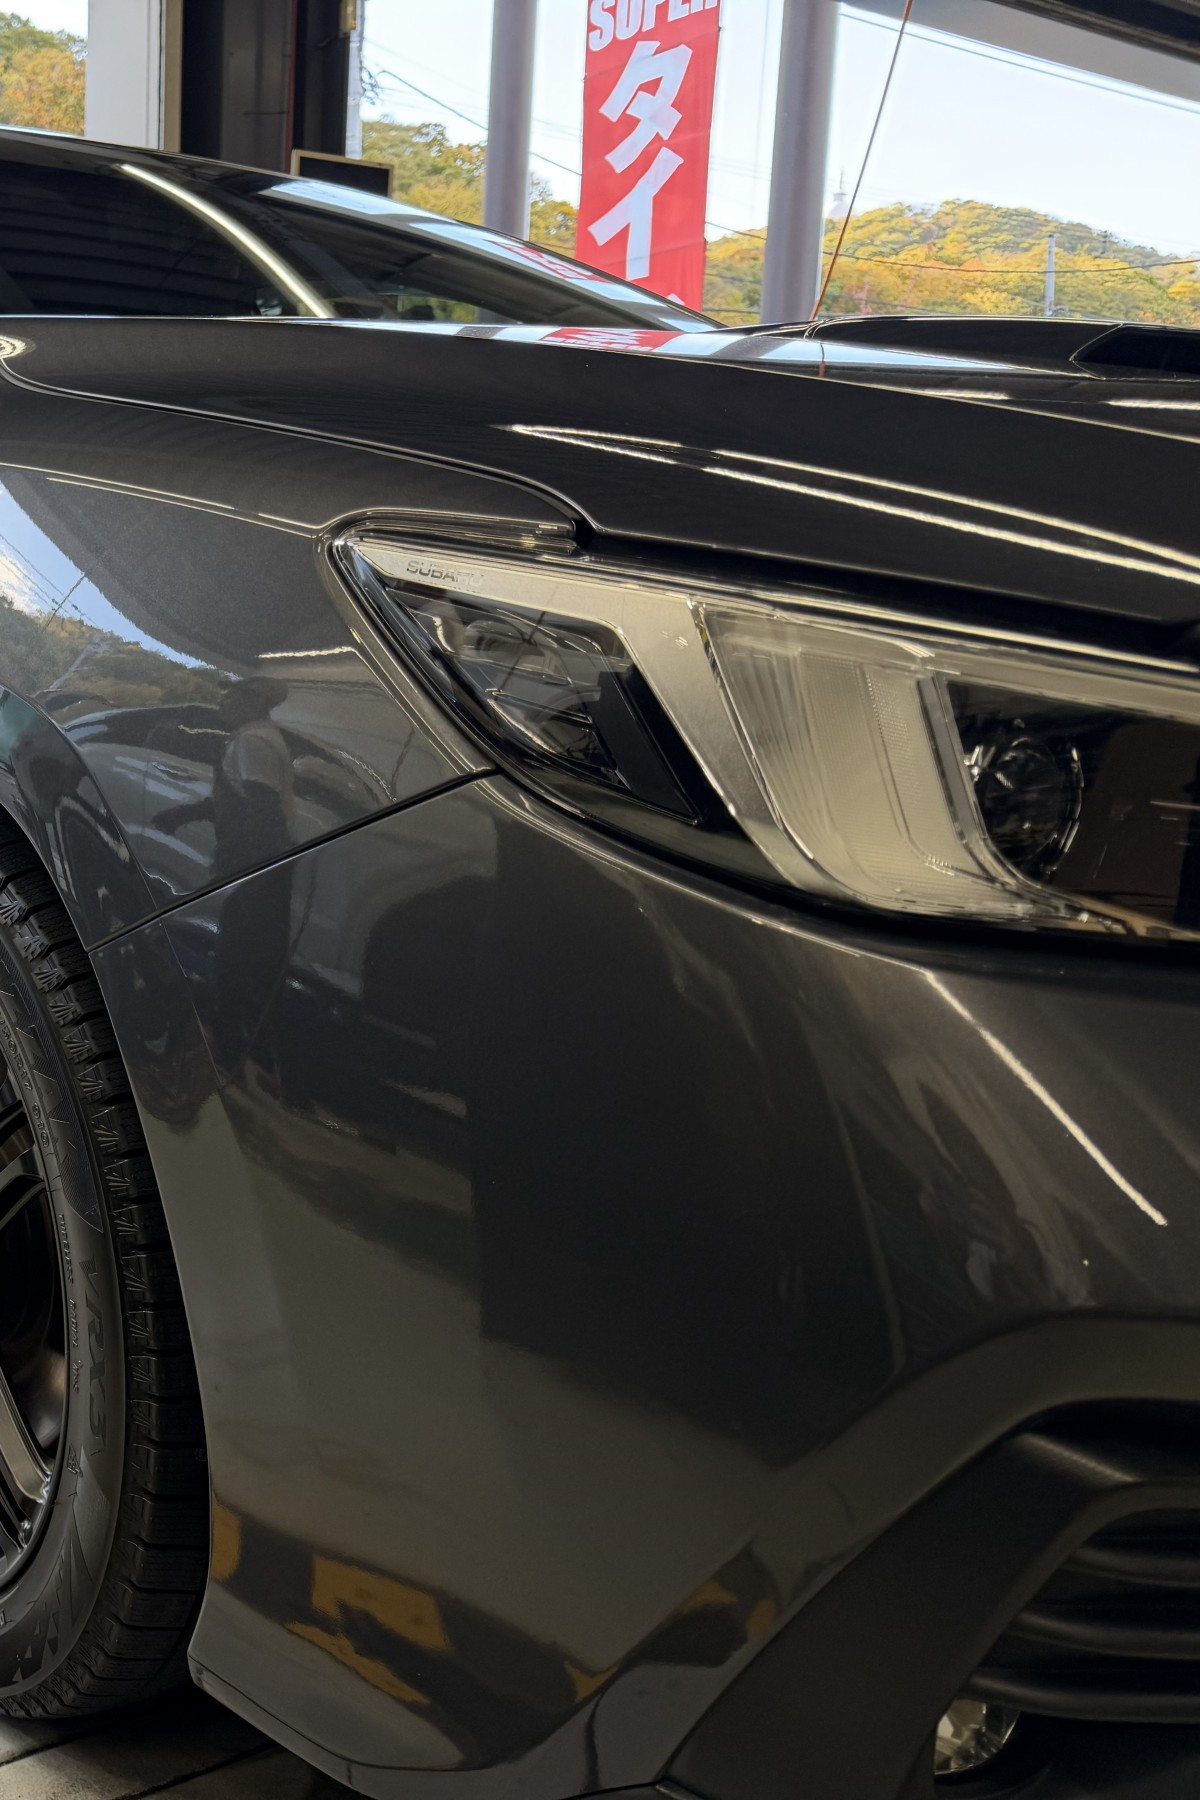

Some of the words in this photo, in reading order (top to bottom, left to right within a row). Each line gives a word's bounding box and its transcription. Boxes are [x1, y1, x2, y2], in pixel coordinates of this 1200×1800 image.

[588, 0, 717, 52] SUP
[587, 40, 693, 304] タイ
[406, 560, 485, 588] SUBARU
[58, 1214, 74, 1284] TUBELESS
[69, 1300, 80, 1348] RADIAL
[78, 1255, 107, 1449] VRX3
